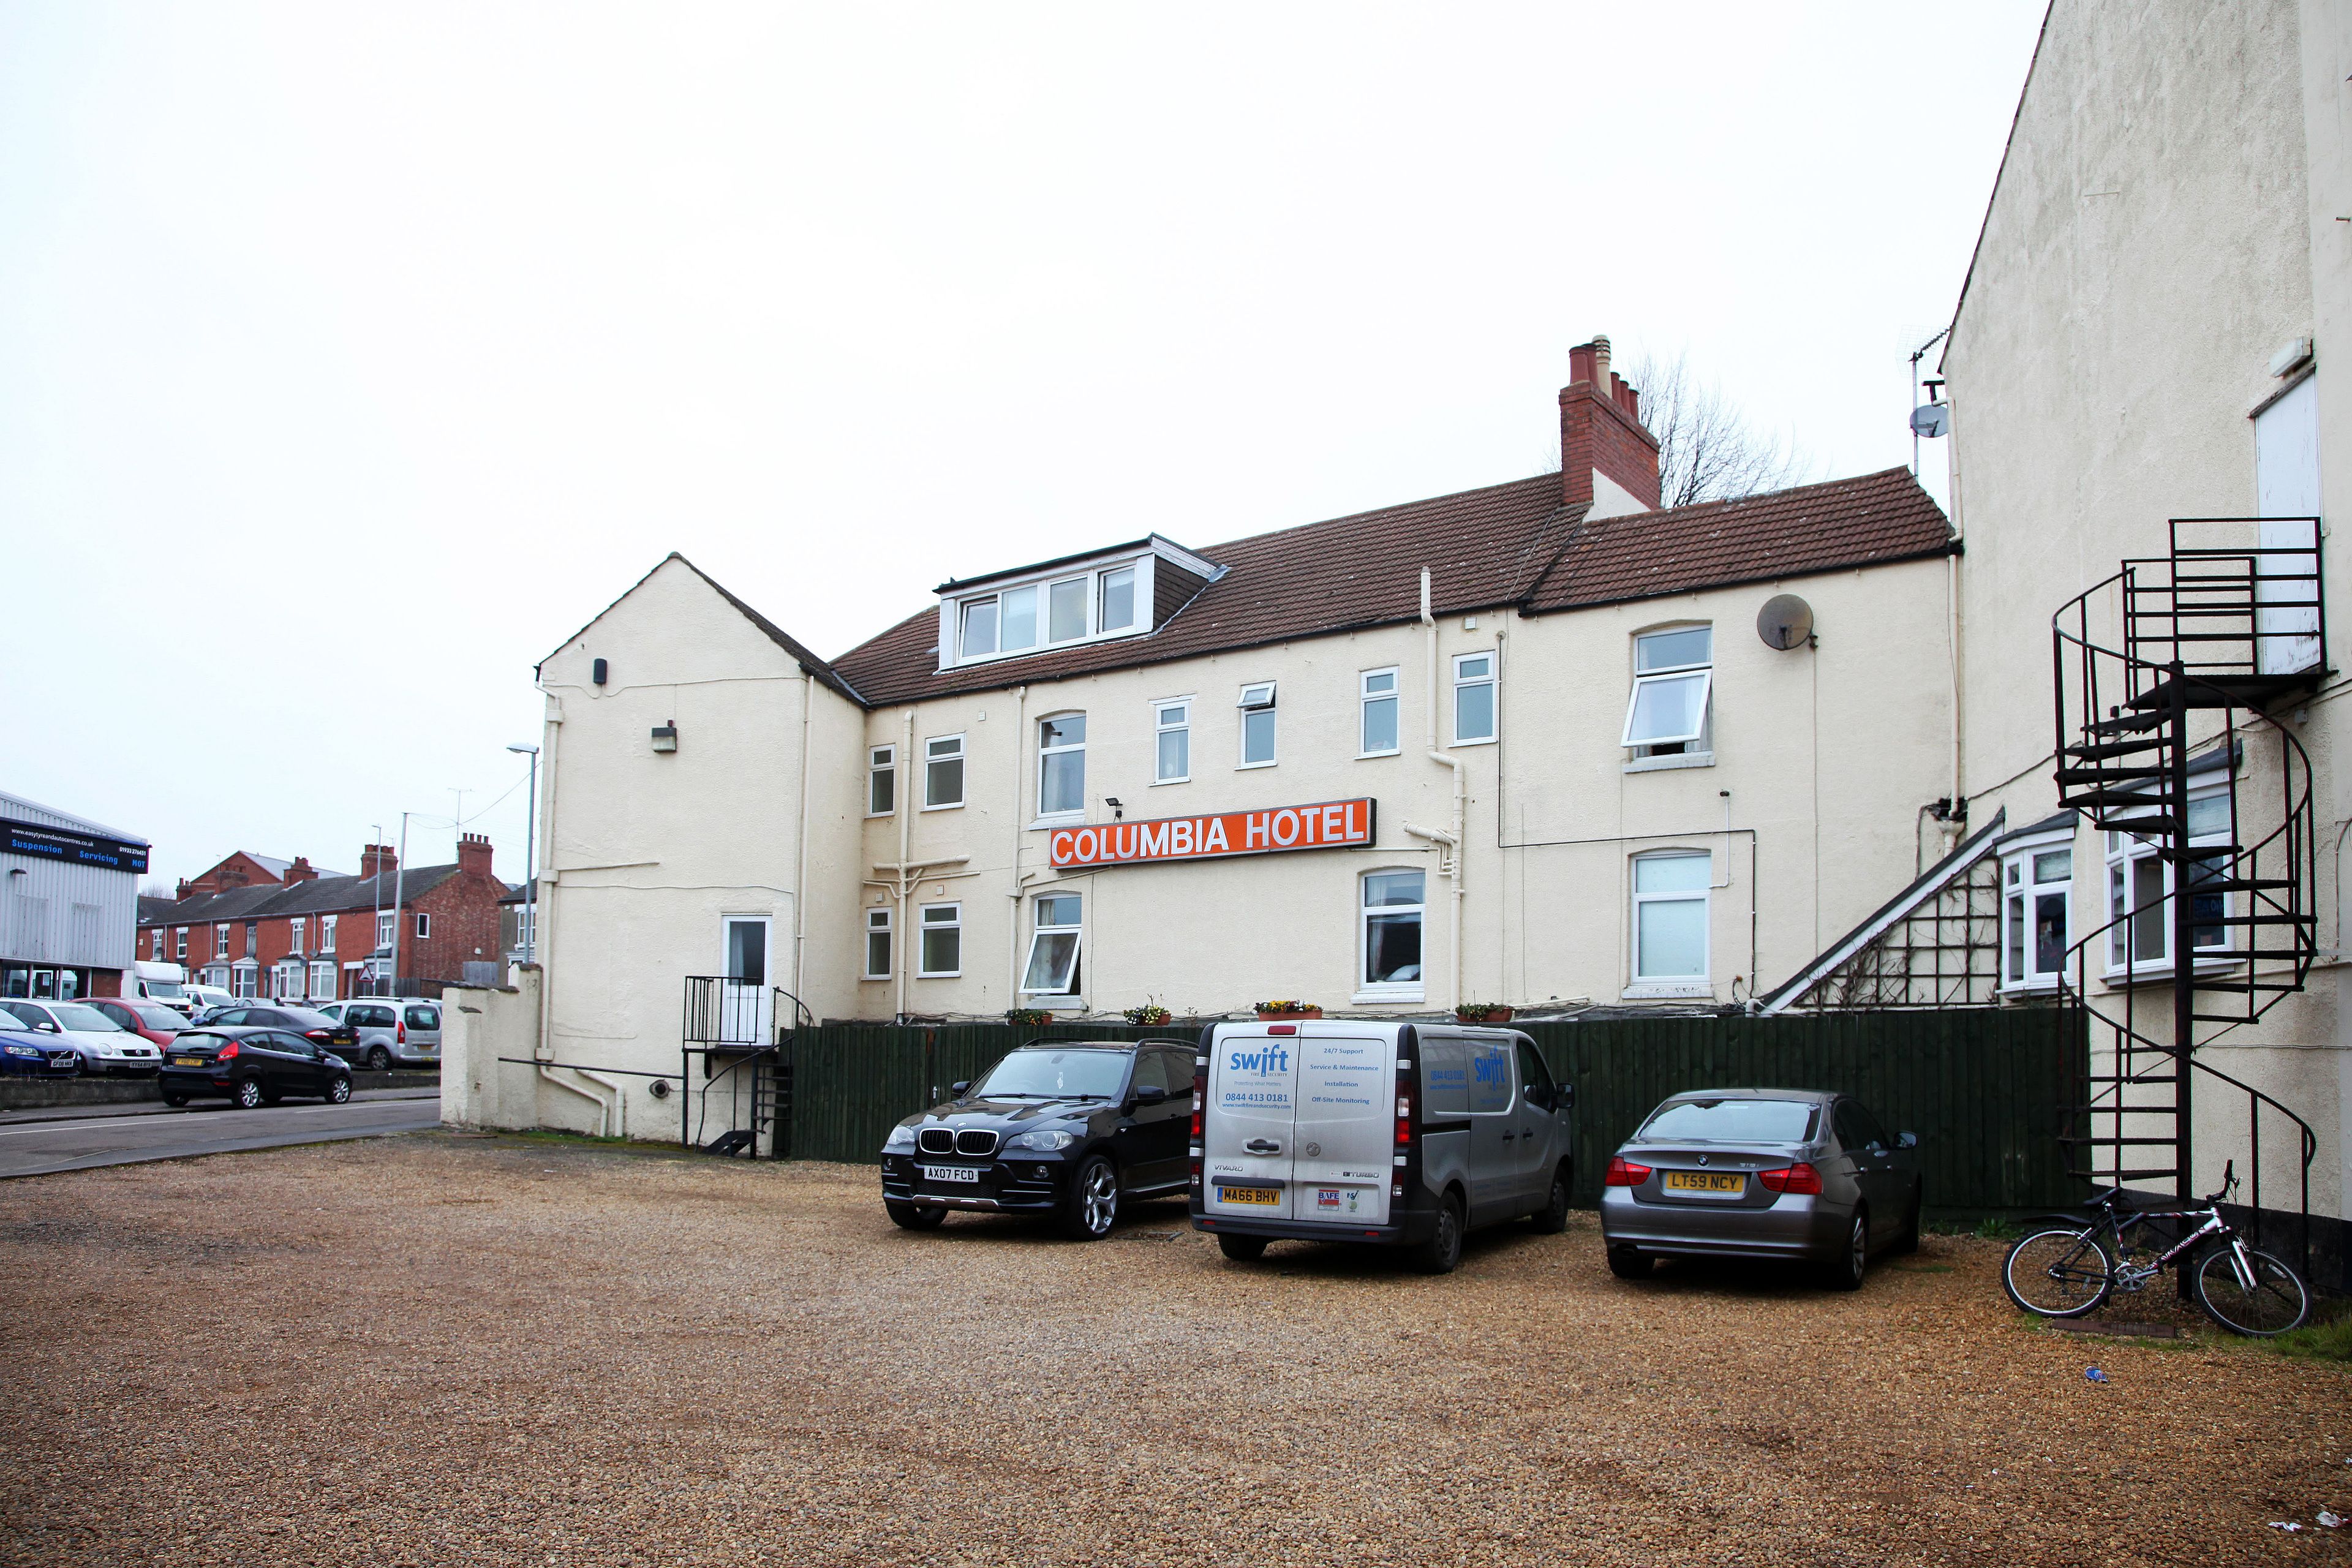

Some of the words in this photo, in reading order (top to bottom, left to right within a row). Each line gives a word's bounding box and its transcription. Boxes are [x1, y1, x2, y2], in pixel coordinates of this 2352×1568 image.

[11, 828, 94, 847] www.easytyreandautocentres.co.uk
[1052, 817, 1229, 864] COLUMBIA
[1246, 804, 1363, 848] HOTEL
[12, 839, 63, 854] Suspension
[79, 850, 118, 865] Servicing
[132, 859, 146, 868] MOT
[1230, 1044, 1289, 1077] swift
[1475, 1045, 1506, 1091] swift
[1248, 1093, 1264, 1102] 413
[1266, 1094, 1288, 1102] 0181
[928, 1167, 952, 1179] AX07
[954, 1169, 974, 1180] FCD
[1672, 1174, 1707, 1188] LT59
[1711, 1176, 1738, 1189] NCY
[1224, 1189, 1253, 1201] MA66
[1256, 1191, 1277, 1202] BHV
